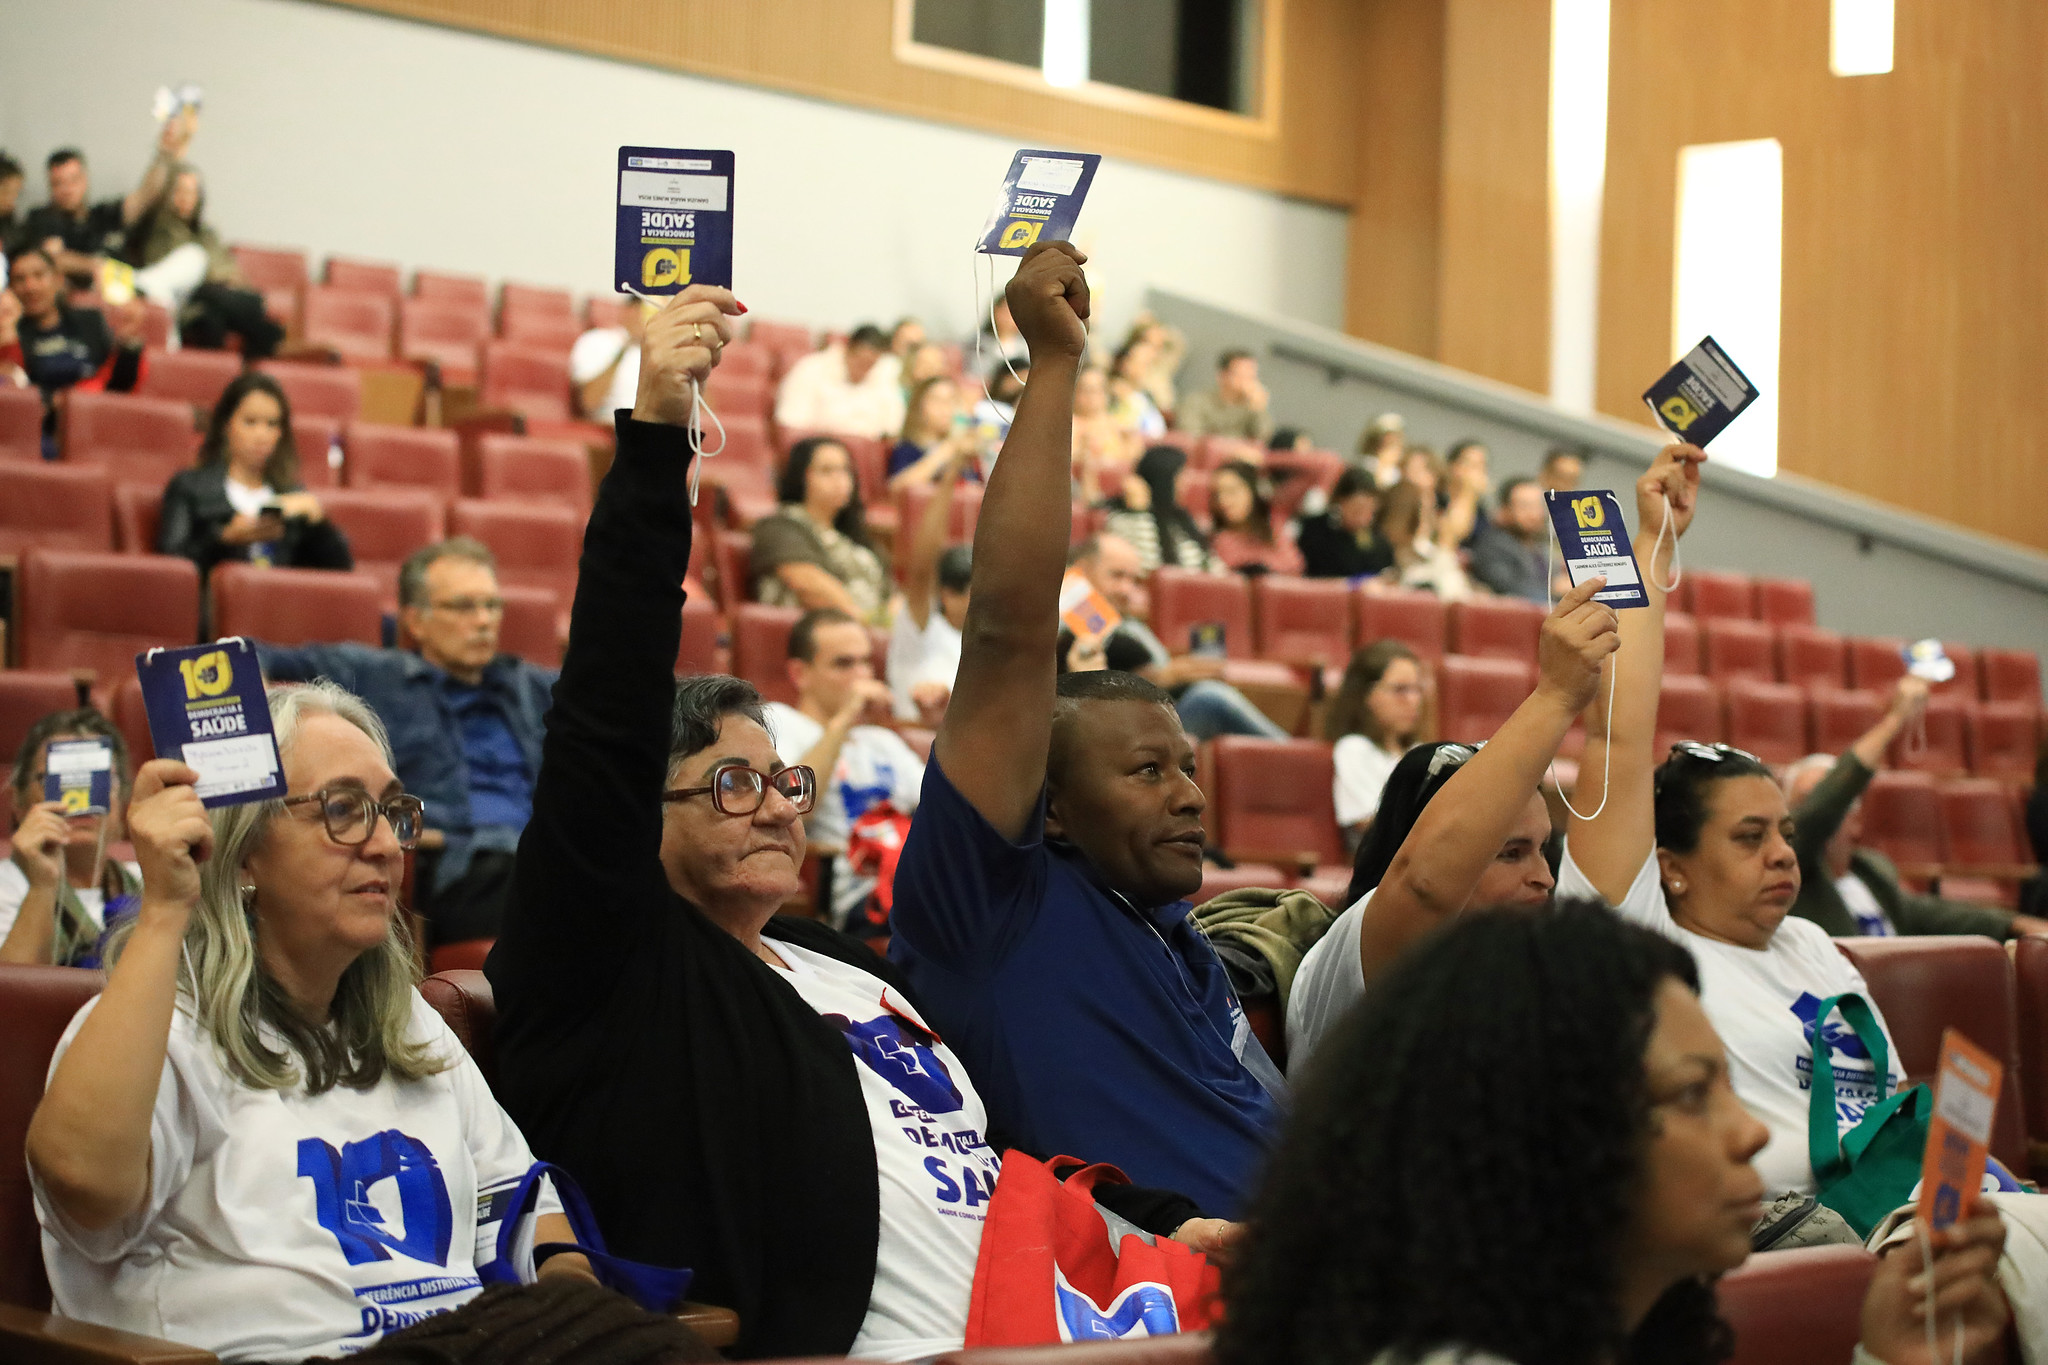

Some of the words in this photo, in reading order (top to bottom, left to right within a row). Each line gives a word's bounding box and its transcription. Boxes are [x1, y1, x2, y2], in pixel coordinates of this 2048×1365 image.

[1014, 195, 1057, 209] SAÚDE
[1016, 207, 1052, 215] DEMOCRACIA
[641, 212, 695, 229] SAÚDE
[641, 228, 646, 236] E
[647, 229, 695, 238] DEMOCRACIA
[641, 248, 693, 287] 10
[1571, 496, 1605, 528] 10
[1580, 536, 1610, 544] DEMOCRACIA
[1583, 543, 1618, 556] SAÚDE
[179, 650, 233, 699] 10
[187, 706, 237, 720] DEMOCRACIA
[190, 714, 247, 738] SAÚDE
